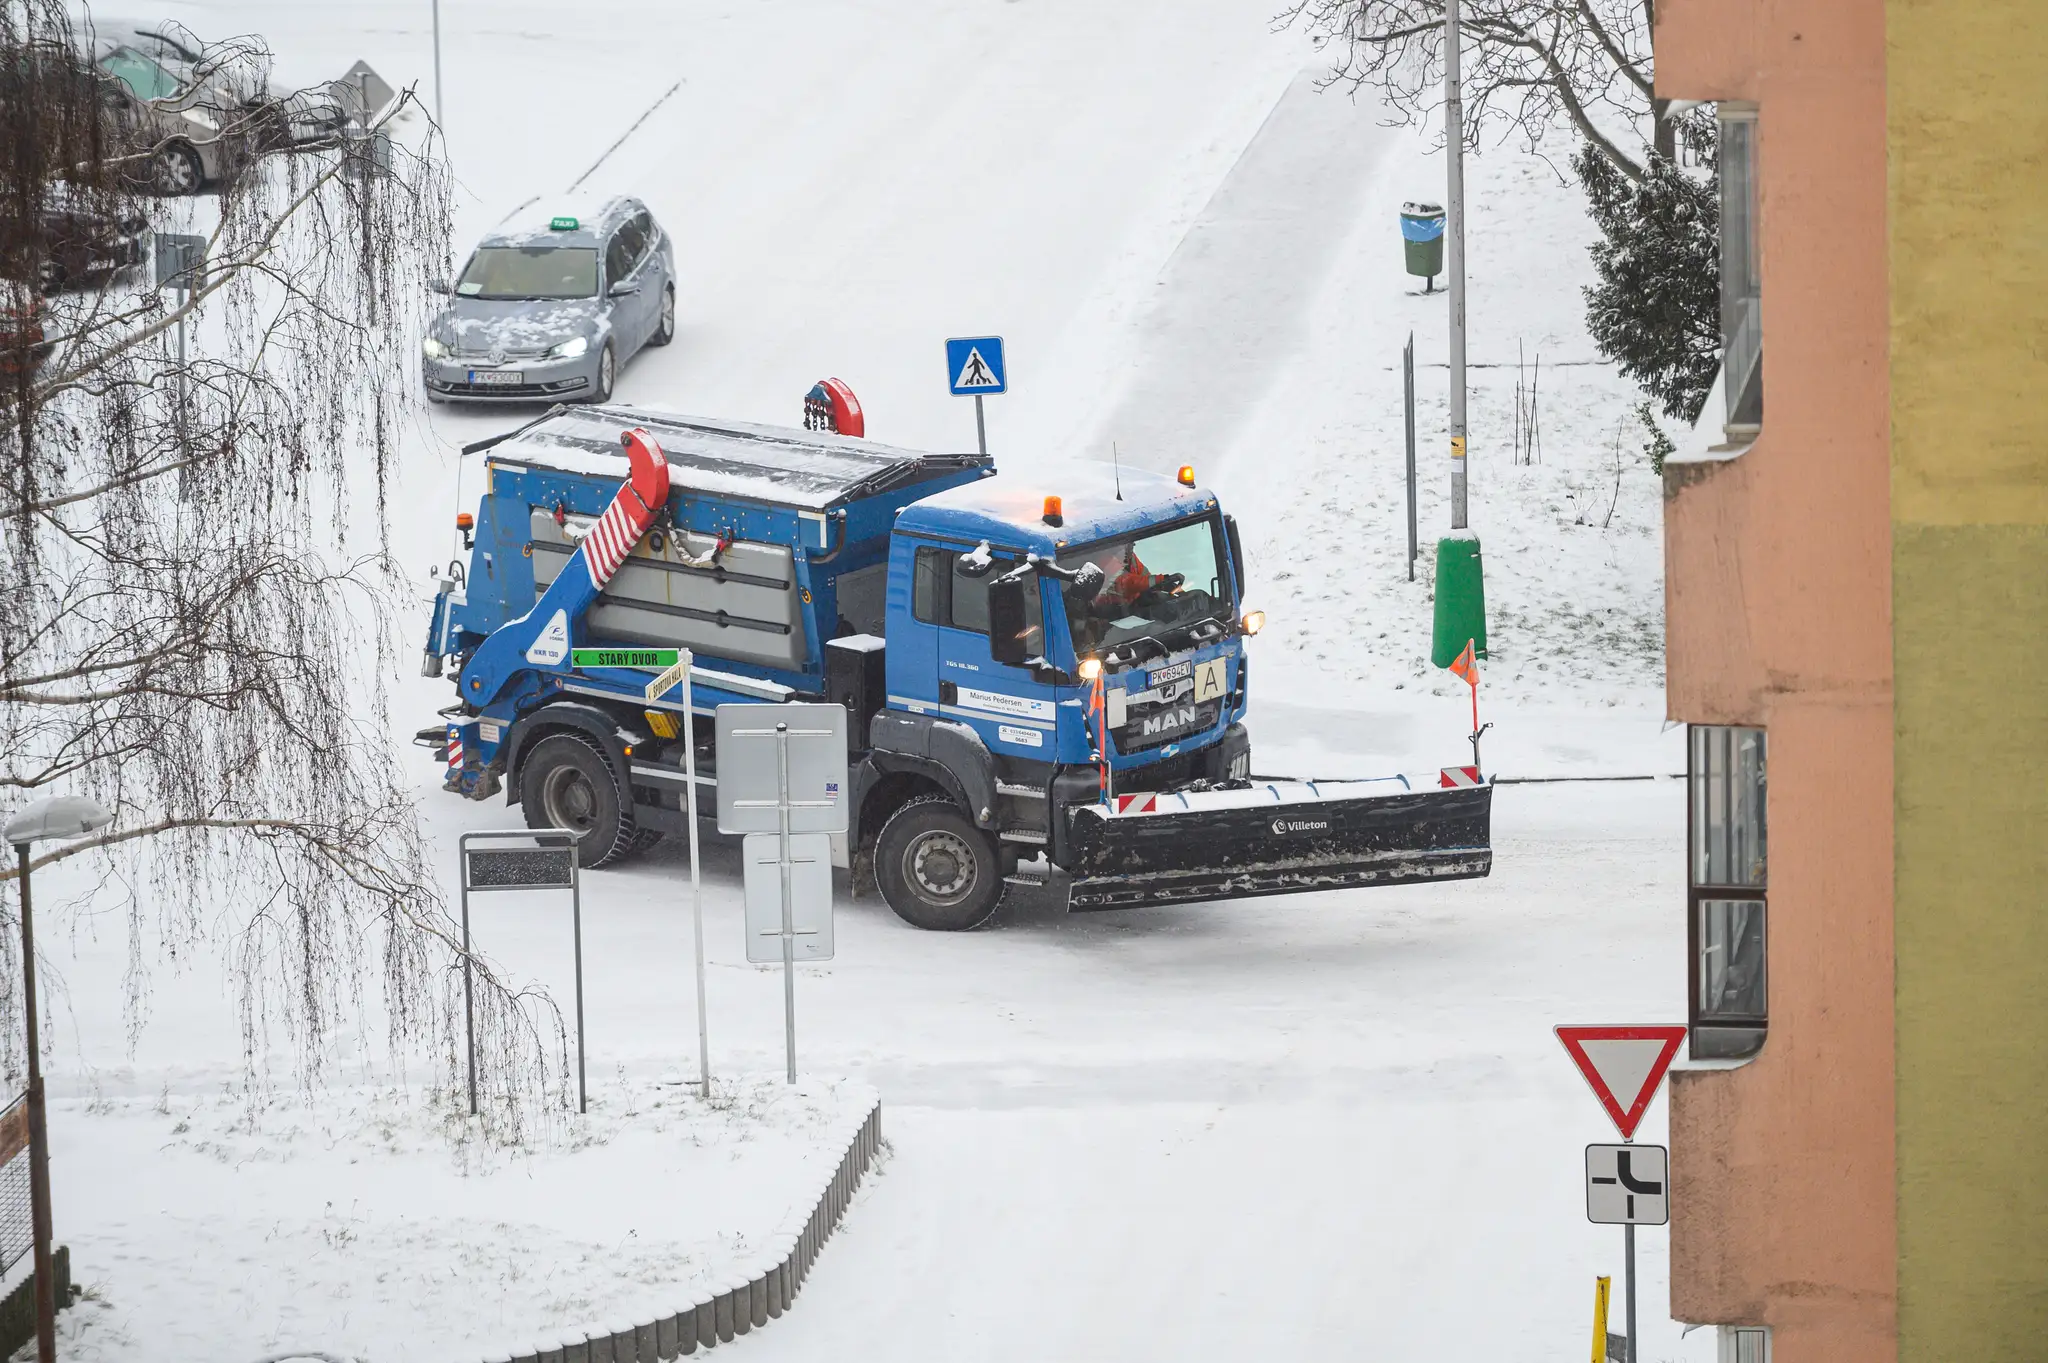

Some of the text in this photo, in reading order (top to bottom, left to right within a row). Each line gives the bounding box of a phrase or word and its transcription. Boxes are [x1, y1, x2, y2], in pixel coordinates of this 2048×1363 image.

[554, 219, 575, 228] TAXI
[549, 650, 559, 658] 130
[598, 650, 658, 666] STARÝ DVOR
[671, 666, 681, 683] HALA
[1203, 666, 1219, 695] A
[969, 691, 1023, 707] Marius Pedersen
[1143, 706, 1196, 736] MAN
[1287, 820, 1328, 831] Villeton
